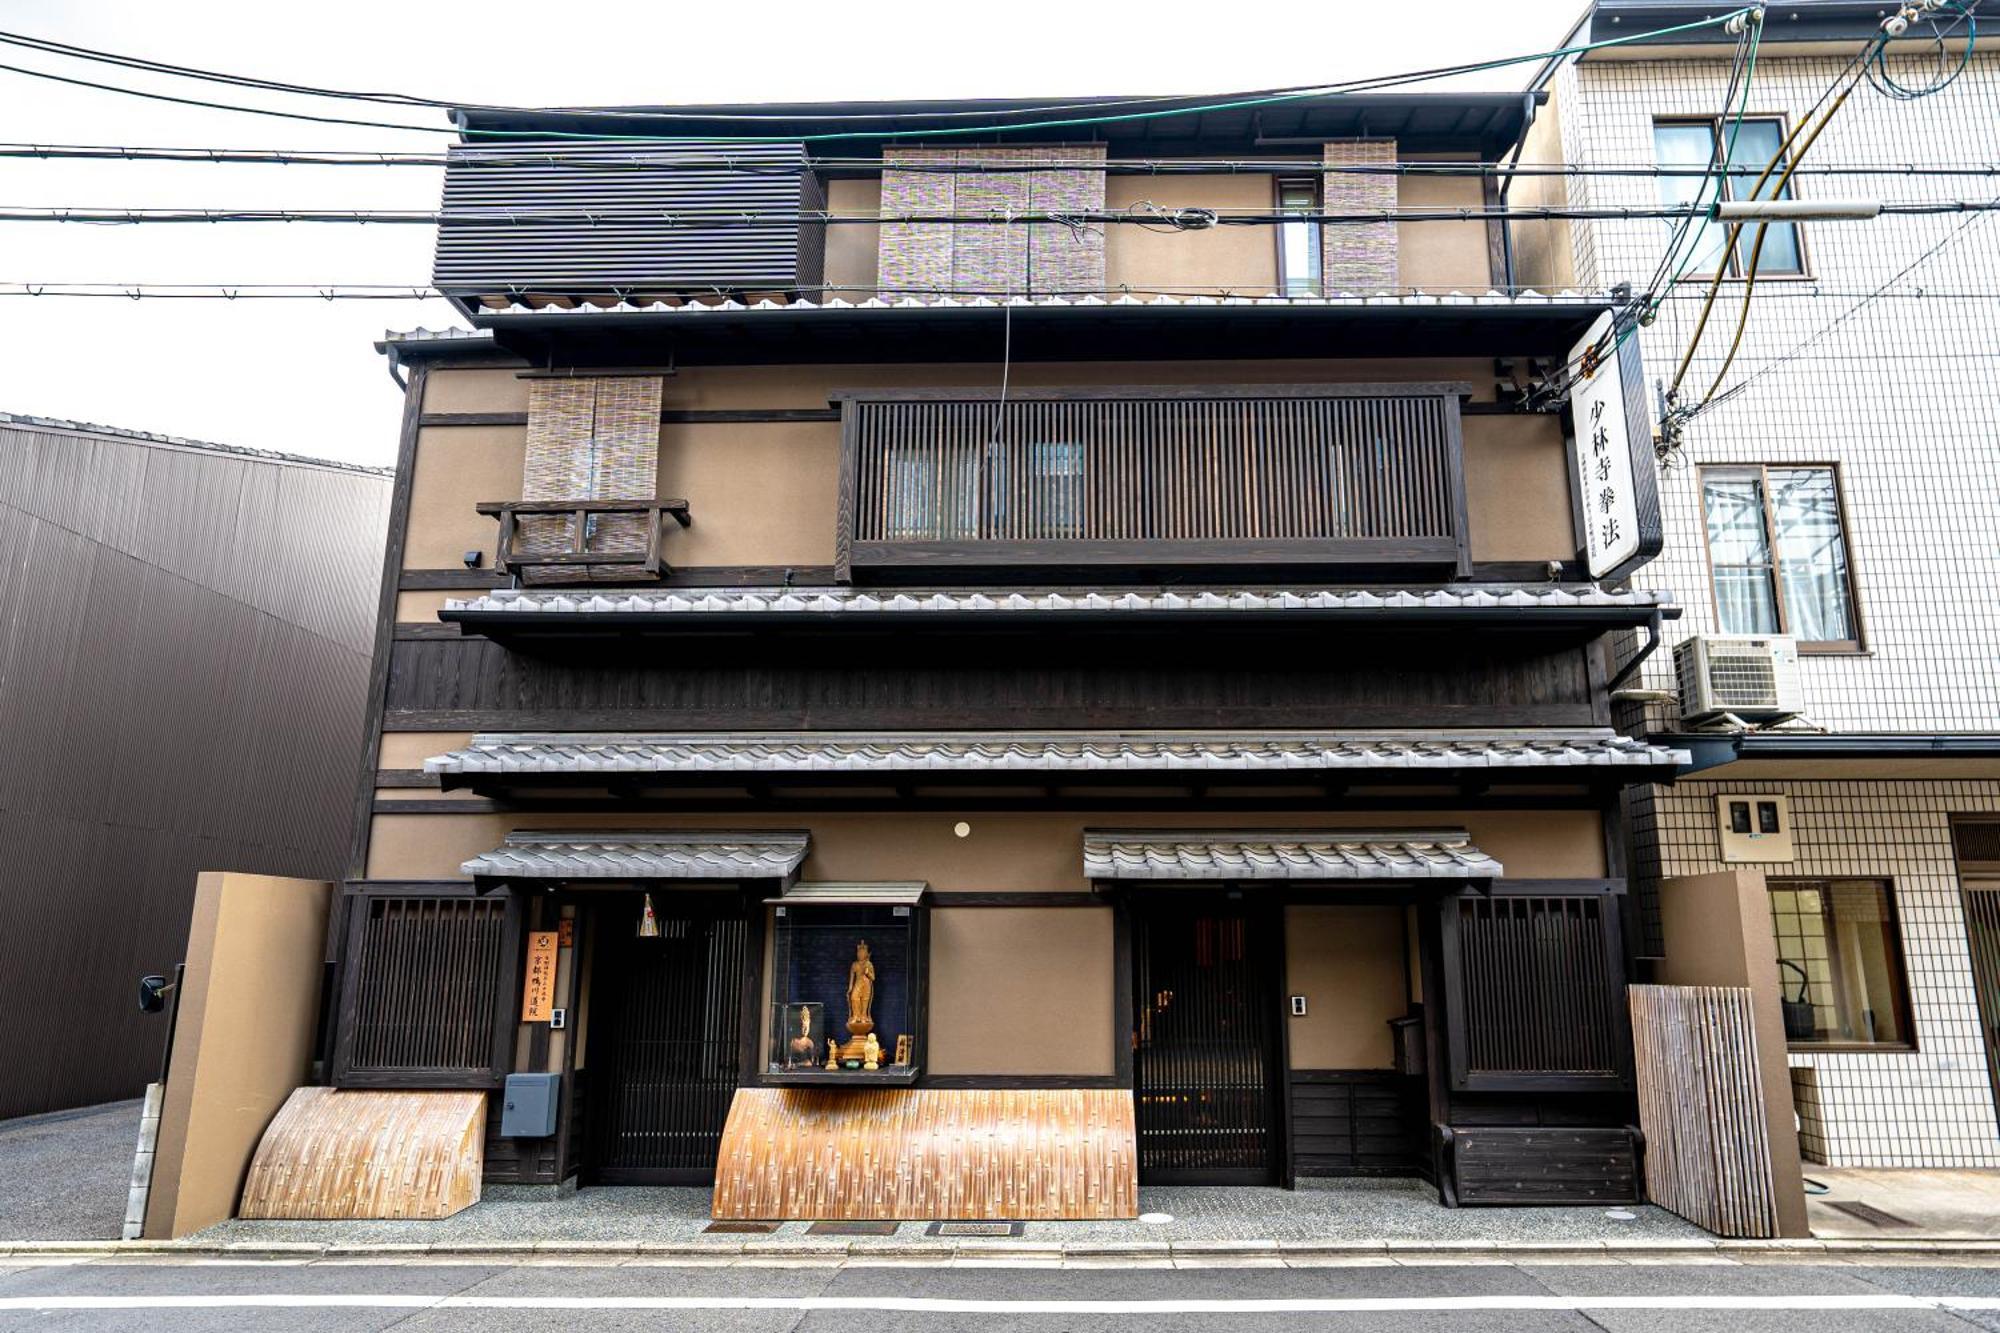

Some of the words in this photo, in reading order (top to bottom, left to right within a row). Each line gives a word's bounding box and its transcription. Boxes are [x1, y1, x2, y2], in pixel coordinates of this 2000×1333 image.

[1590, 400, 1621, 550] 少林寺拳法
